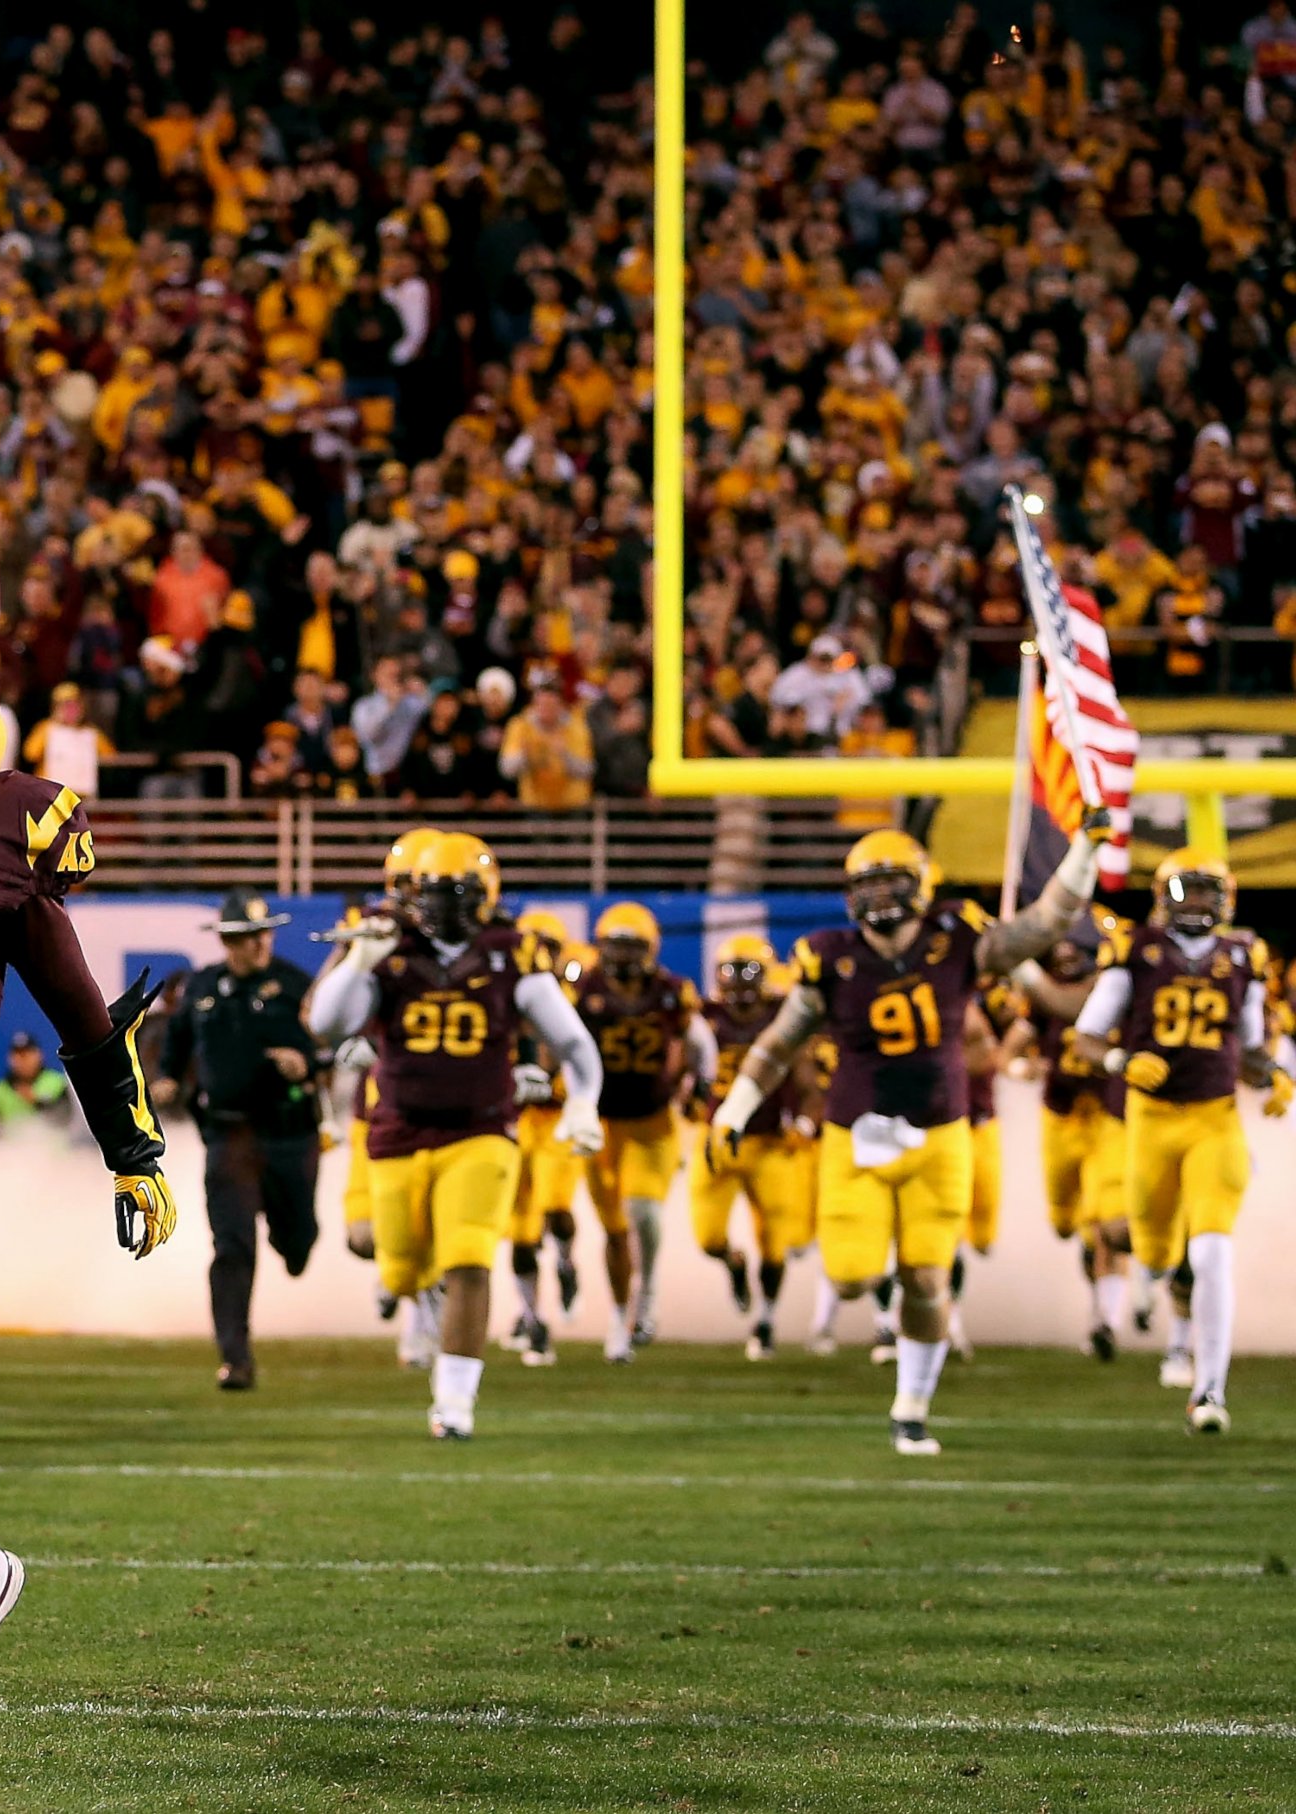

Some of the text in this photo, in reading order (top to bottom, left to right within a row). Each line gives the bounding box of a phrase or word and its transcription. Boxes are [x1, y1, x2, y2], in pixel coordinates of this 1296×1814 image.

[403, 1000, 488, 1057] 90
[869, 982, 942, 1056] 91
[1154, 985, 1229, 1050] 82
